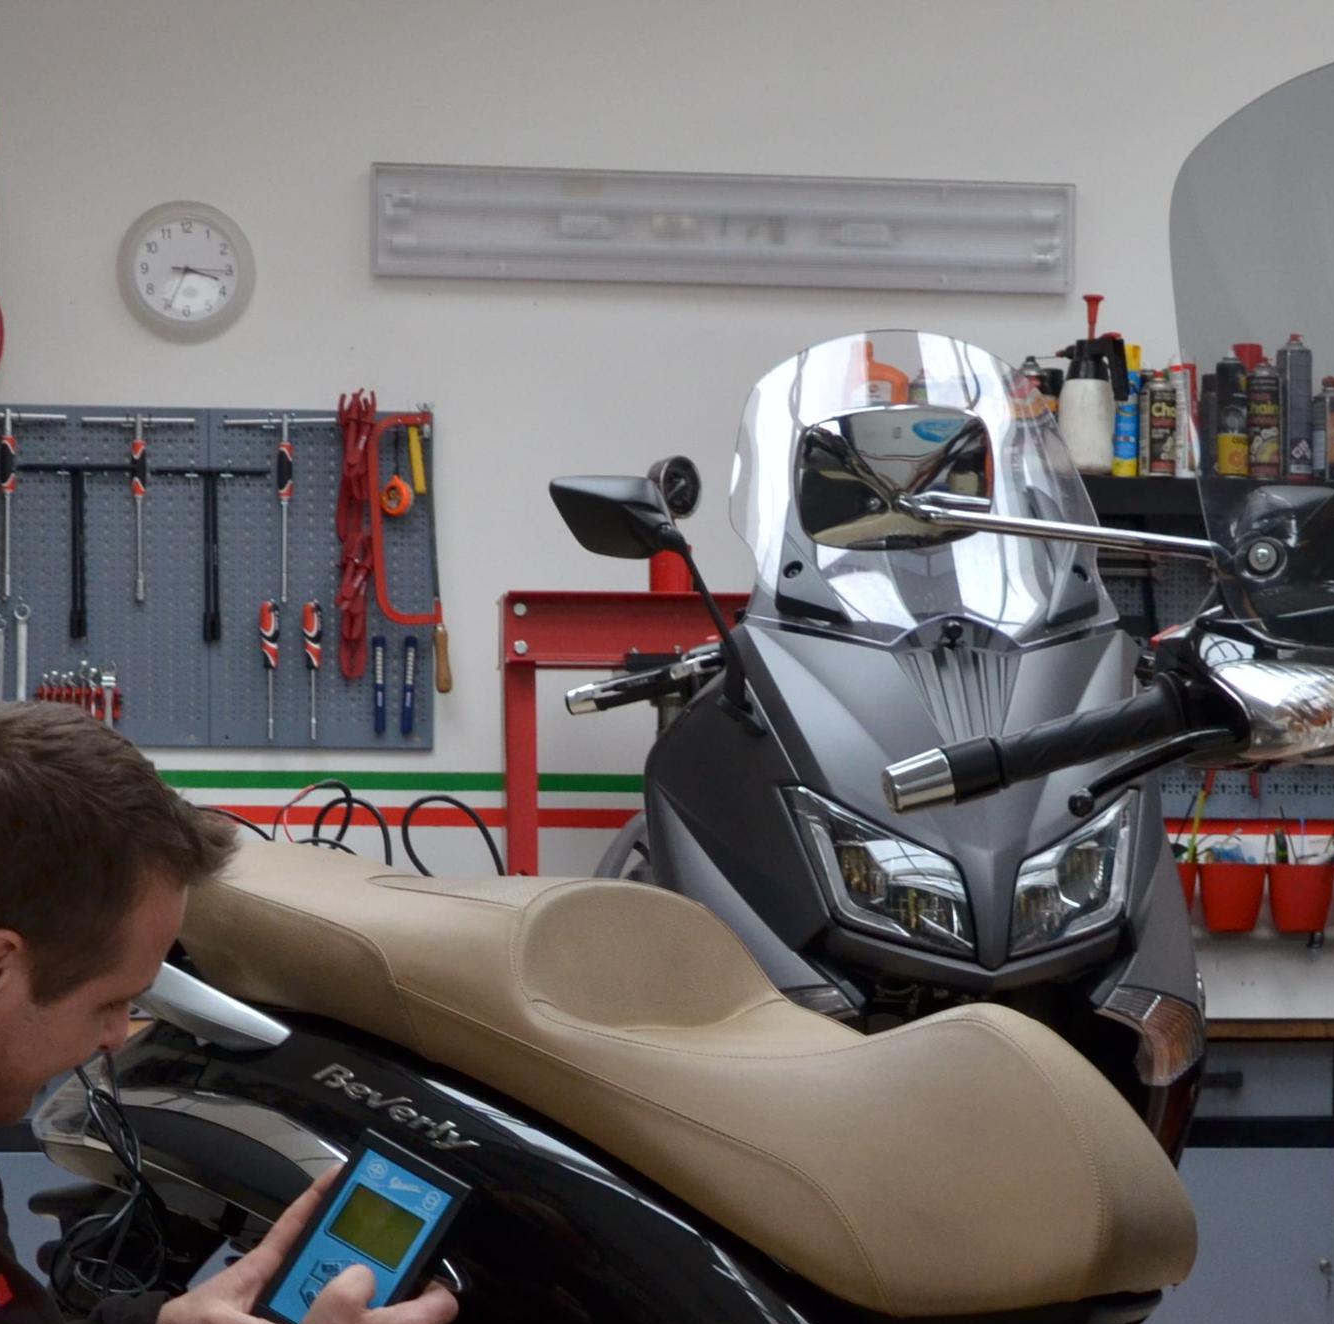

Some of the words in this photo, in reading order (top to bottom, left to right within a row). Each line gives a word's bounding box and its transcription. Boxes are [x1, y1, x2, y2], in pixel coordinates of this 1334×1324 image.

[181, 222, 193, 233] 12
[161, 228, 172, 239] 11
[204, 229, 211, 239] 1
[146, 242, 157, 253] 10
[219, 243, 228, 254] 2
[140, 263, 148, 274] 9
[226, 264, 233, 275] 3
[146, 283, 154, 295] 8
[219, 285, 226, 296] 4
[204, 300, 212, 311] 5
[182, 306, 190, 317] 6
[313, 1063, 480, 1149] Beverly
